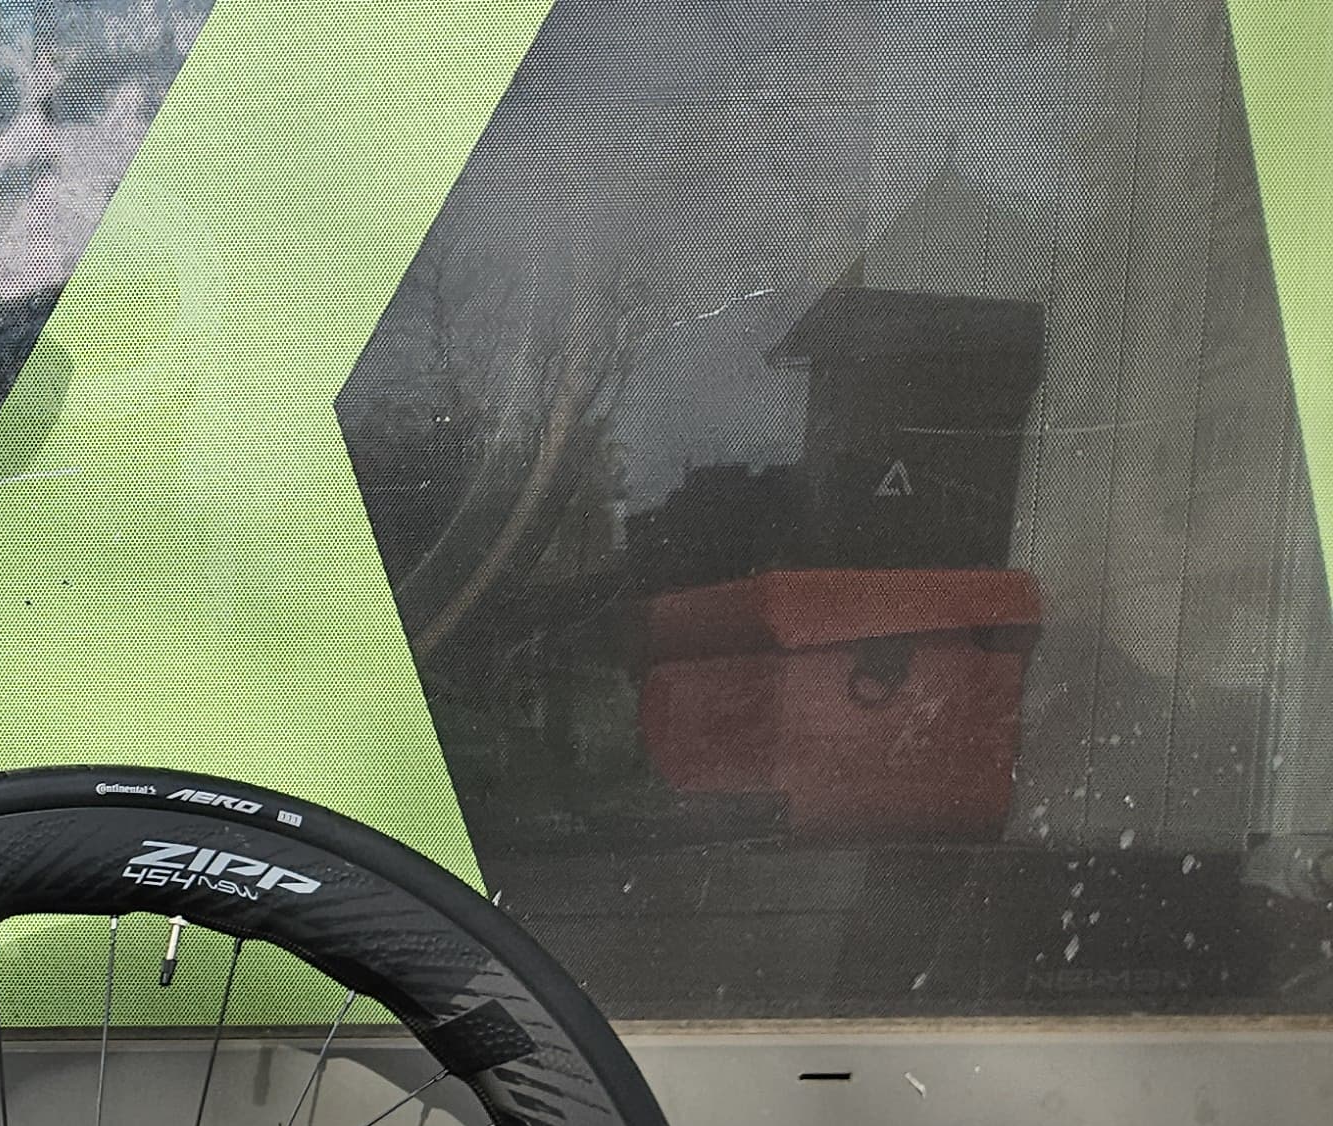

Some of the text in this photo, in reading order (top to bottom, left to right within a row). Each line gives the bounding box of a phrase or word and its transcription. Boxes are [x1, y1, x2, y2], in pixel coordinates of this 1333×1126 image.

[95, 782, 149, 796] Continental
[166, 788, 265, 815] AERO
[122, 866, 197, 889] 454
[129, 840, 322, 894] ZIPP
